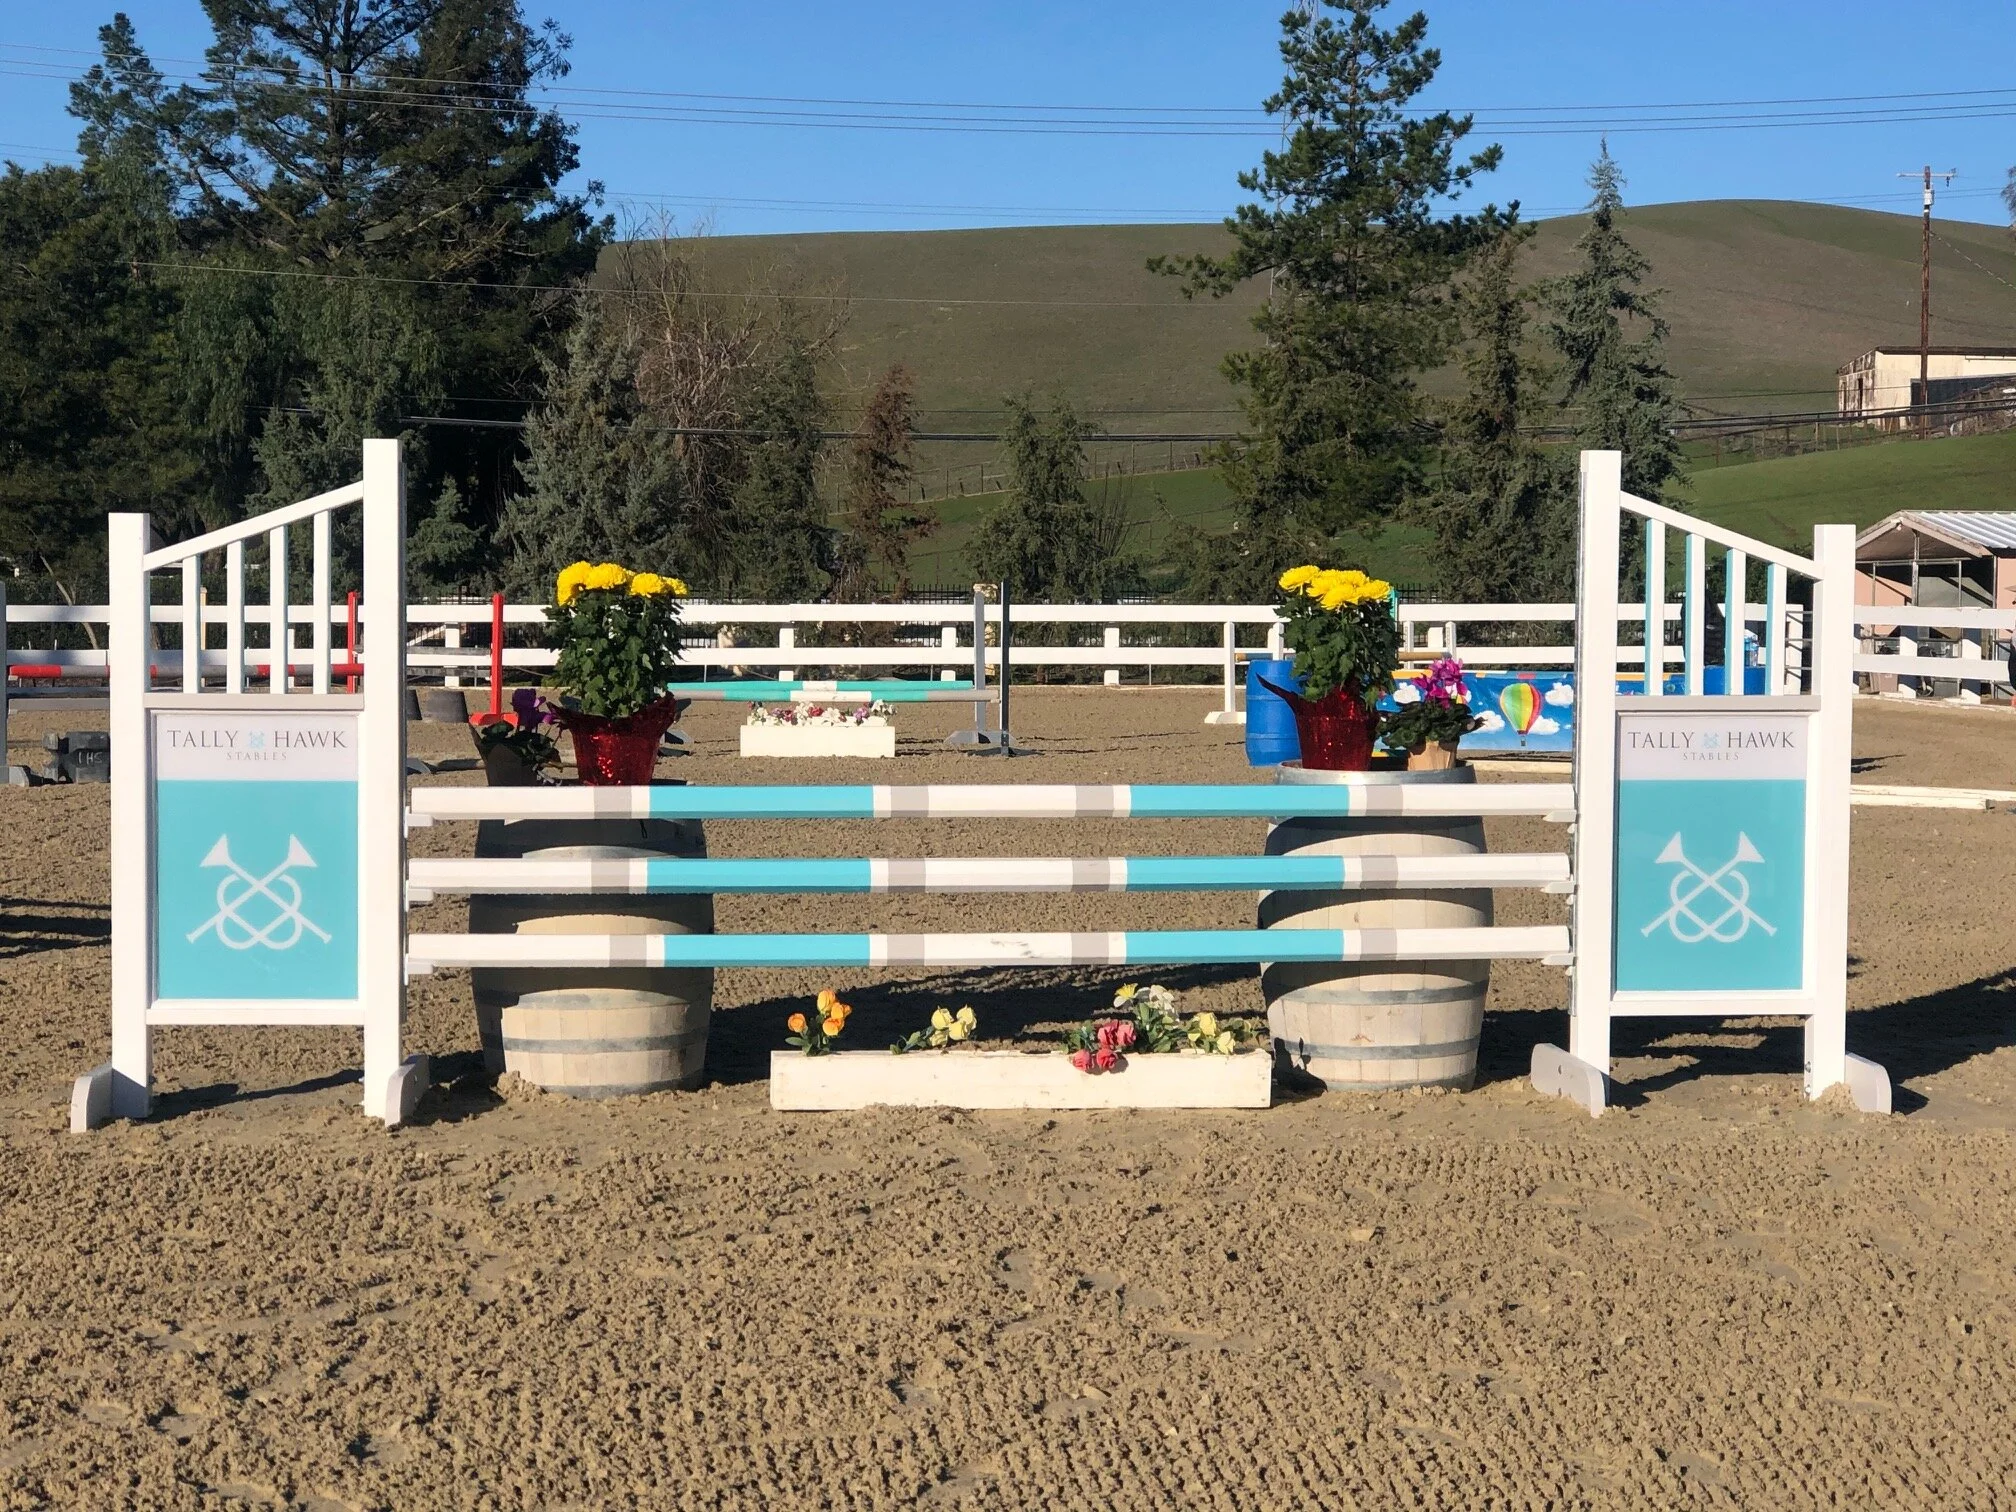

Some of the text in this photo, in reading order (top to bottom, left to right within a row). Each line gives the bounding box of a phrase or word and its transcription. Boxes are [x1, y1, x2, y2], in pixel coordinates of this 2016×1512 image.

[167, 731, 347, 748] TALLY HAWK
[1627, 732, 1795, 748] TALLY HAWK
[226, 752, 287, 760] STABLES
[1683, 752, 1739, 760] STABLES
